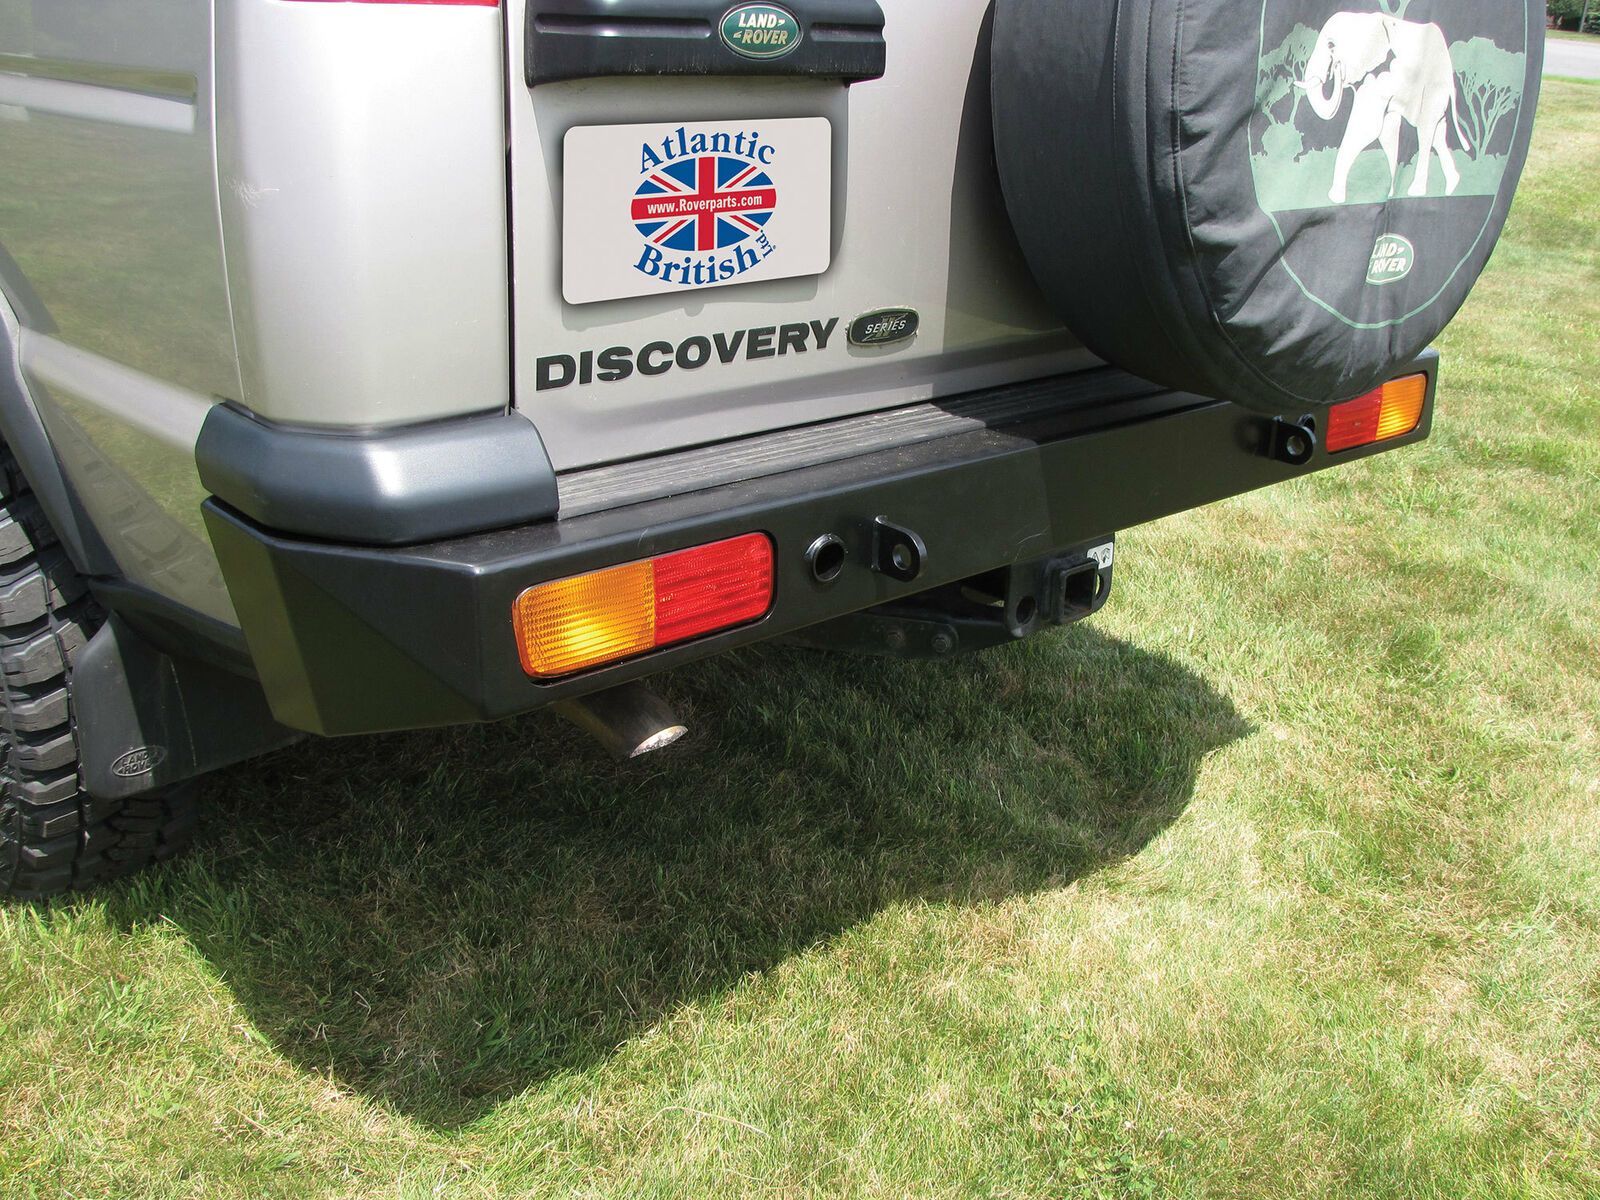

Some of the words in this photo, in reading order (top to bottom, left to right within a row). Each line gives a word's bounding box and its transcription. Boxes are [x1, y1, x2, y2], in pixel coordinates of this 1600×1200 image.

[738, 13, 777, 29] LAND
[741, 29, 789, 45] ROVER
[640, 127, 776, 174] Atlantic
[647, 195, 763, 214] www.Roverparts.com
[633, 243, 762, 285] British
[865, 320, 907, 334] SERIES
[536, 317, 839, 391] DISCOVERY
